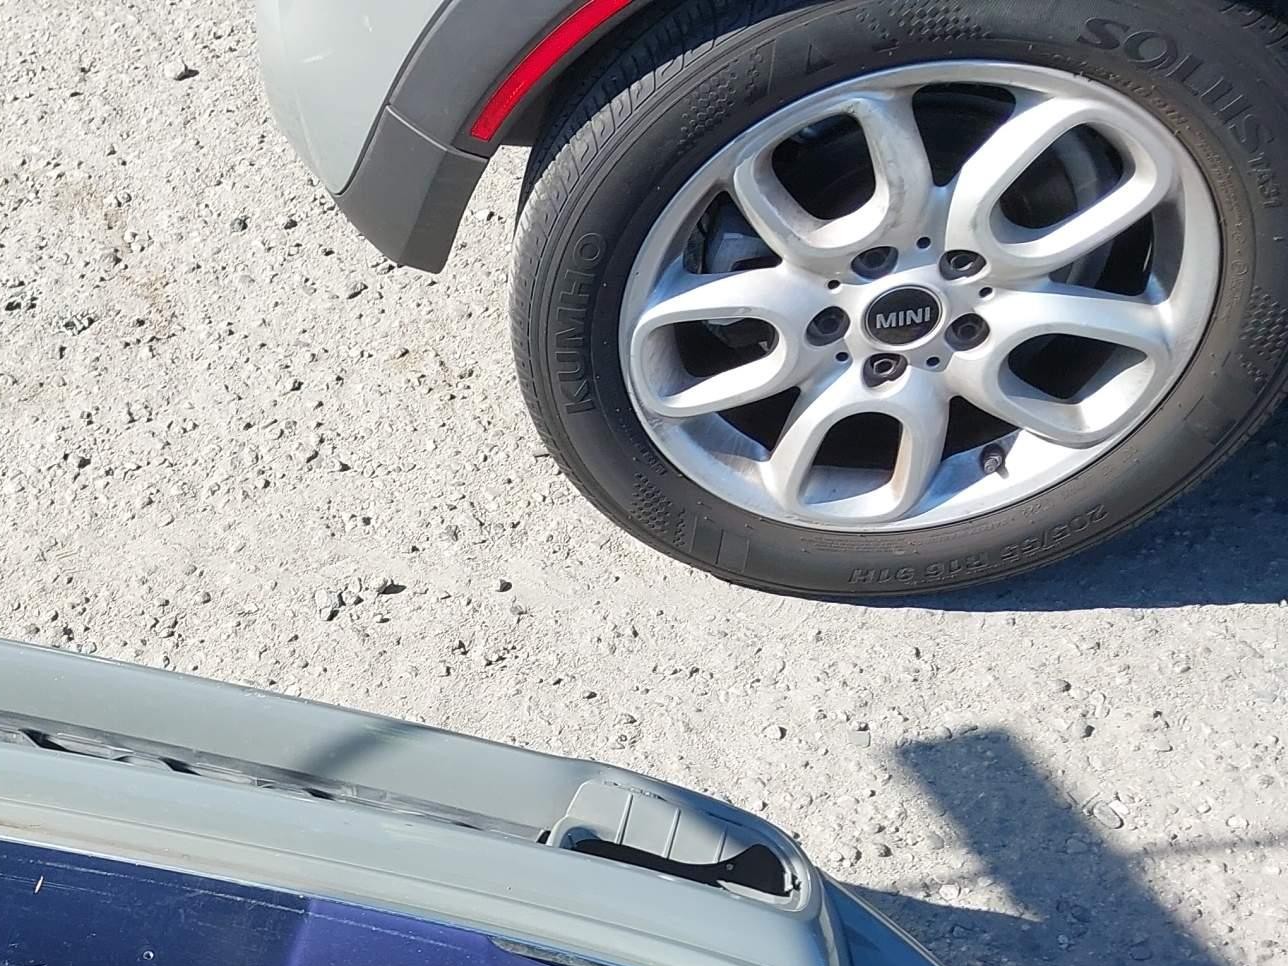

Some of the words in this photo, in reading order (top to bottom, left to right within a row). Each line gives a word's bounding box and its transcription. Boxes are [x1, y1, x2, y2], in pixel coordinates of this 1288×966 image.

[1076, 16, 1275, 151] SOLUS
[554, 231, 607, 415] KUMHO
[876, 306, 931, 329] MINI
